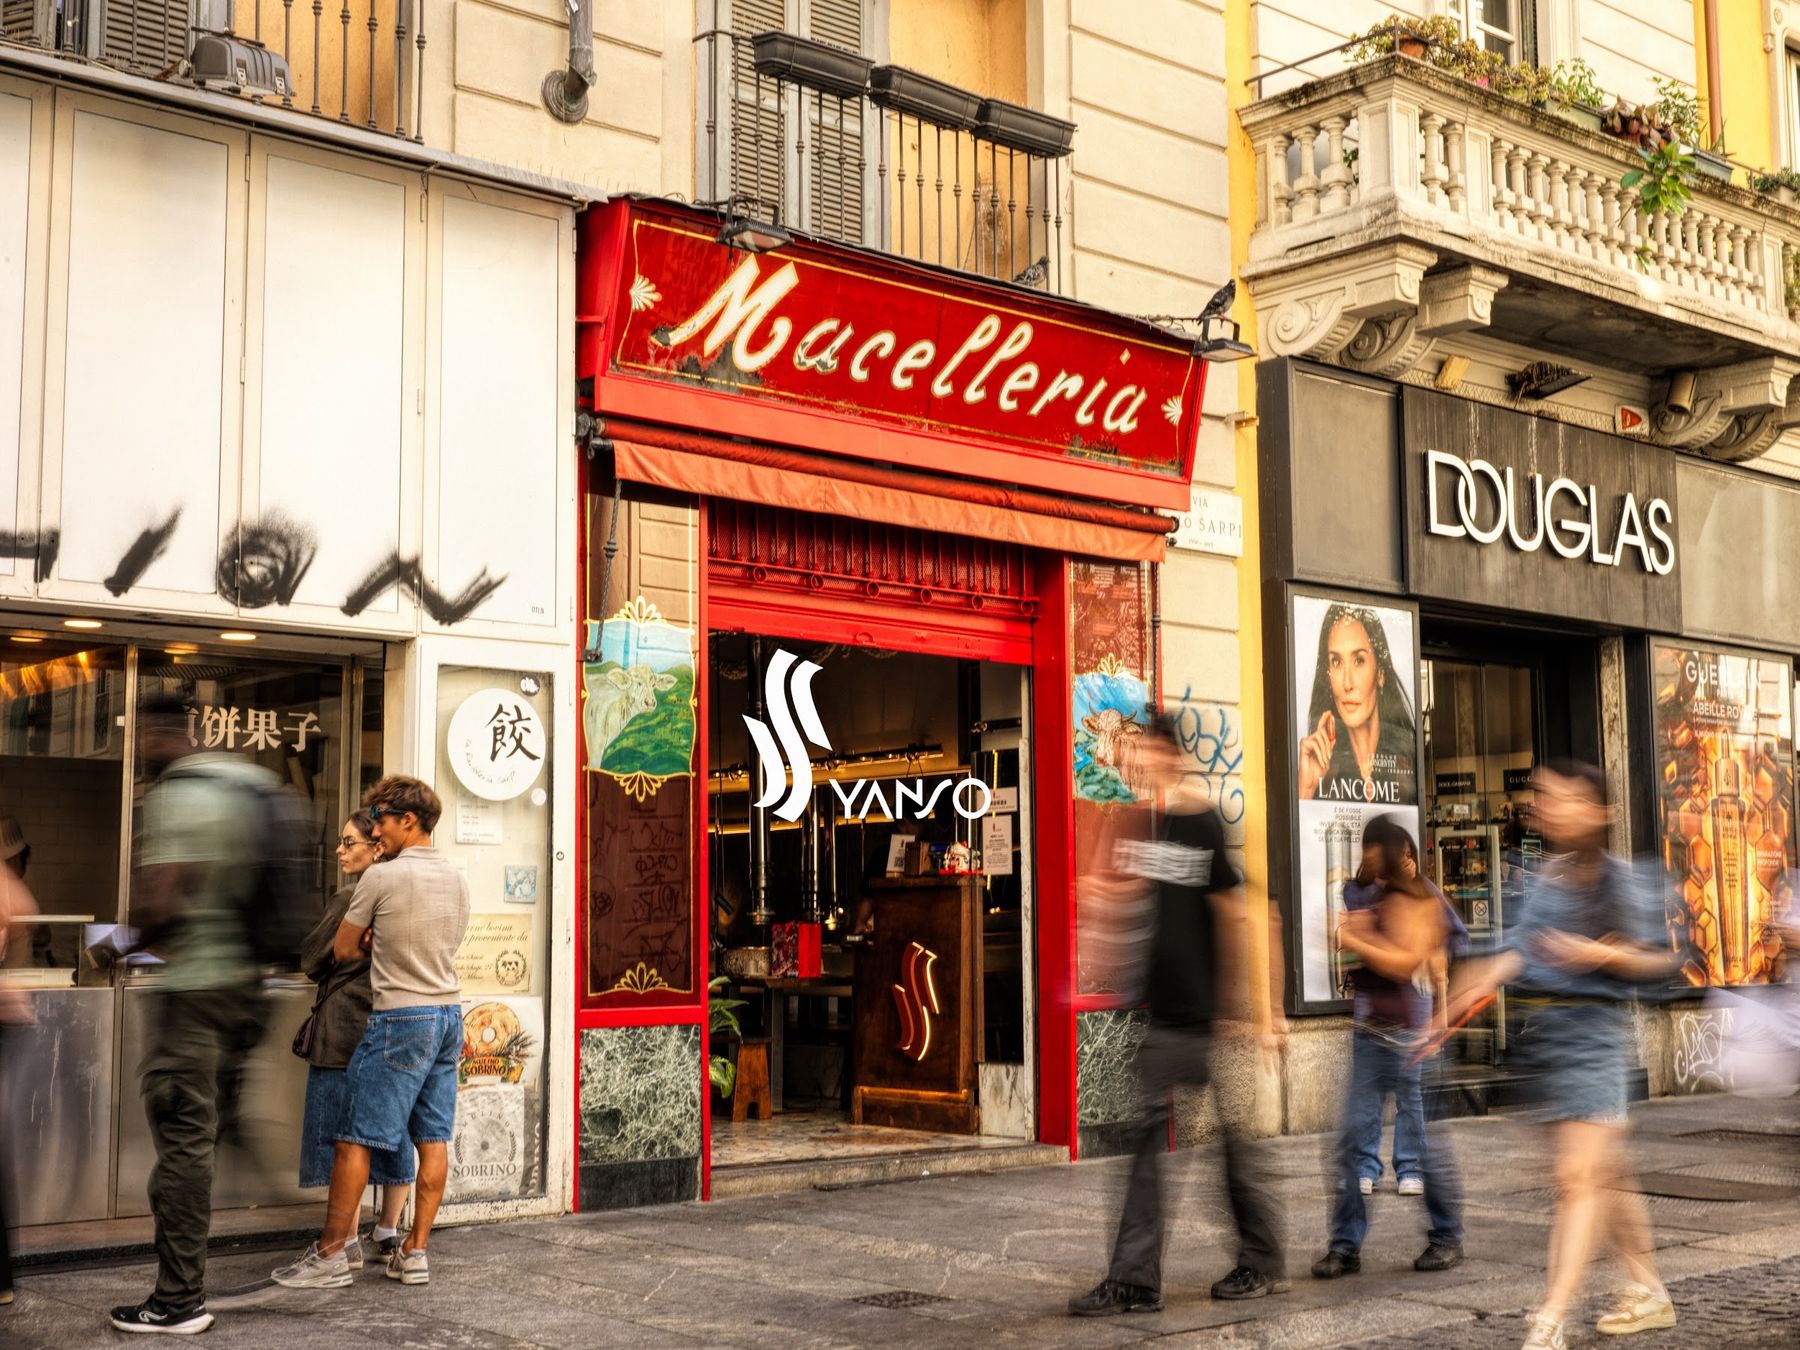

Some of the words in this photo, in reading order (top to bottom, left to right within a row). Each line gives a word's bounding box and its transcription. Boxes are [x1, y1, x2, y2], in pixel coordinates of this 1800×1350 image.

[649, 253, 1148, 434] Macelleria
[1192, 495, 1208, 508] VIA
[1427, 449, 1675, 576] DOUGLAS
[1199, 517, 1242, 539] SARPI
[1693, 702, 1726, 718] ABEILLE
[484, 703, 541, 762] 餃
[1509, 775, 1533, 784] GUCC
[517, 930, 528, 942] da
[464, 1065, 506, 1076] SOBRINO
[452, 1163, 517, 1178] SOBRINO
